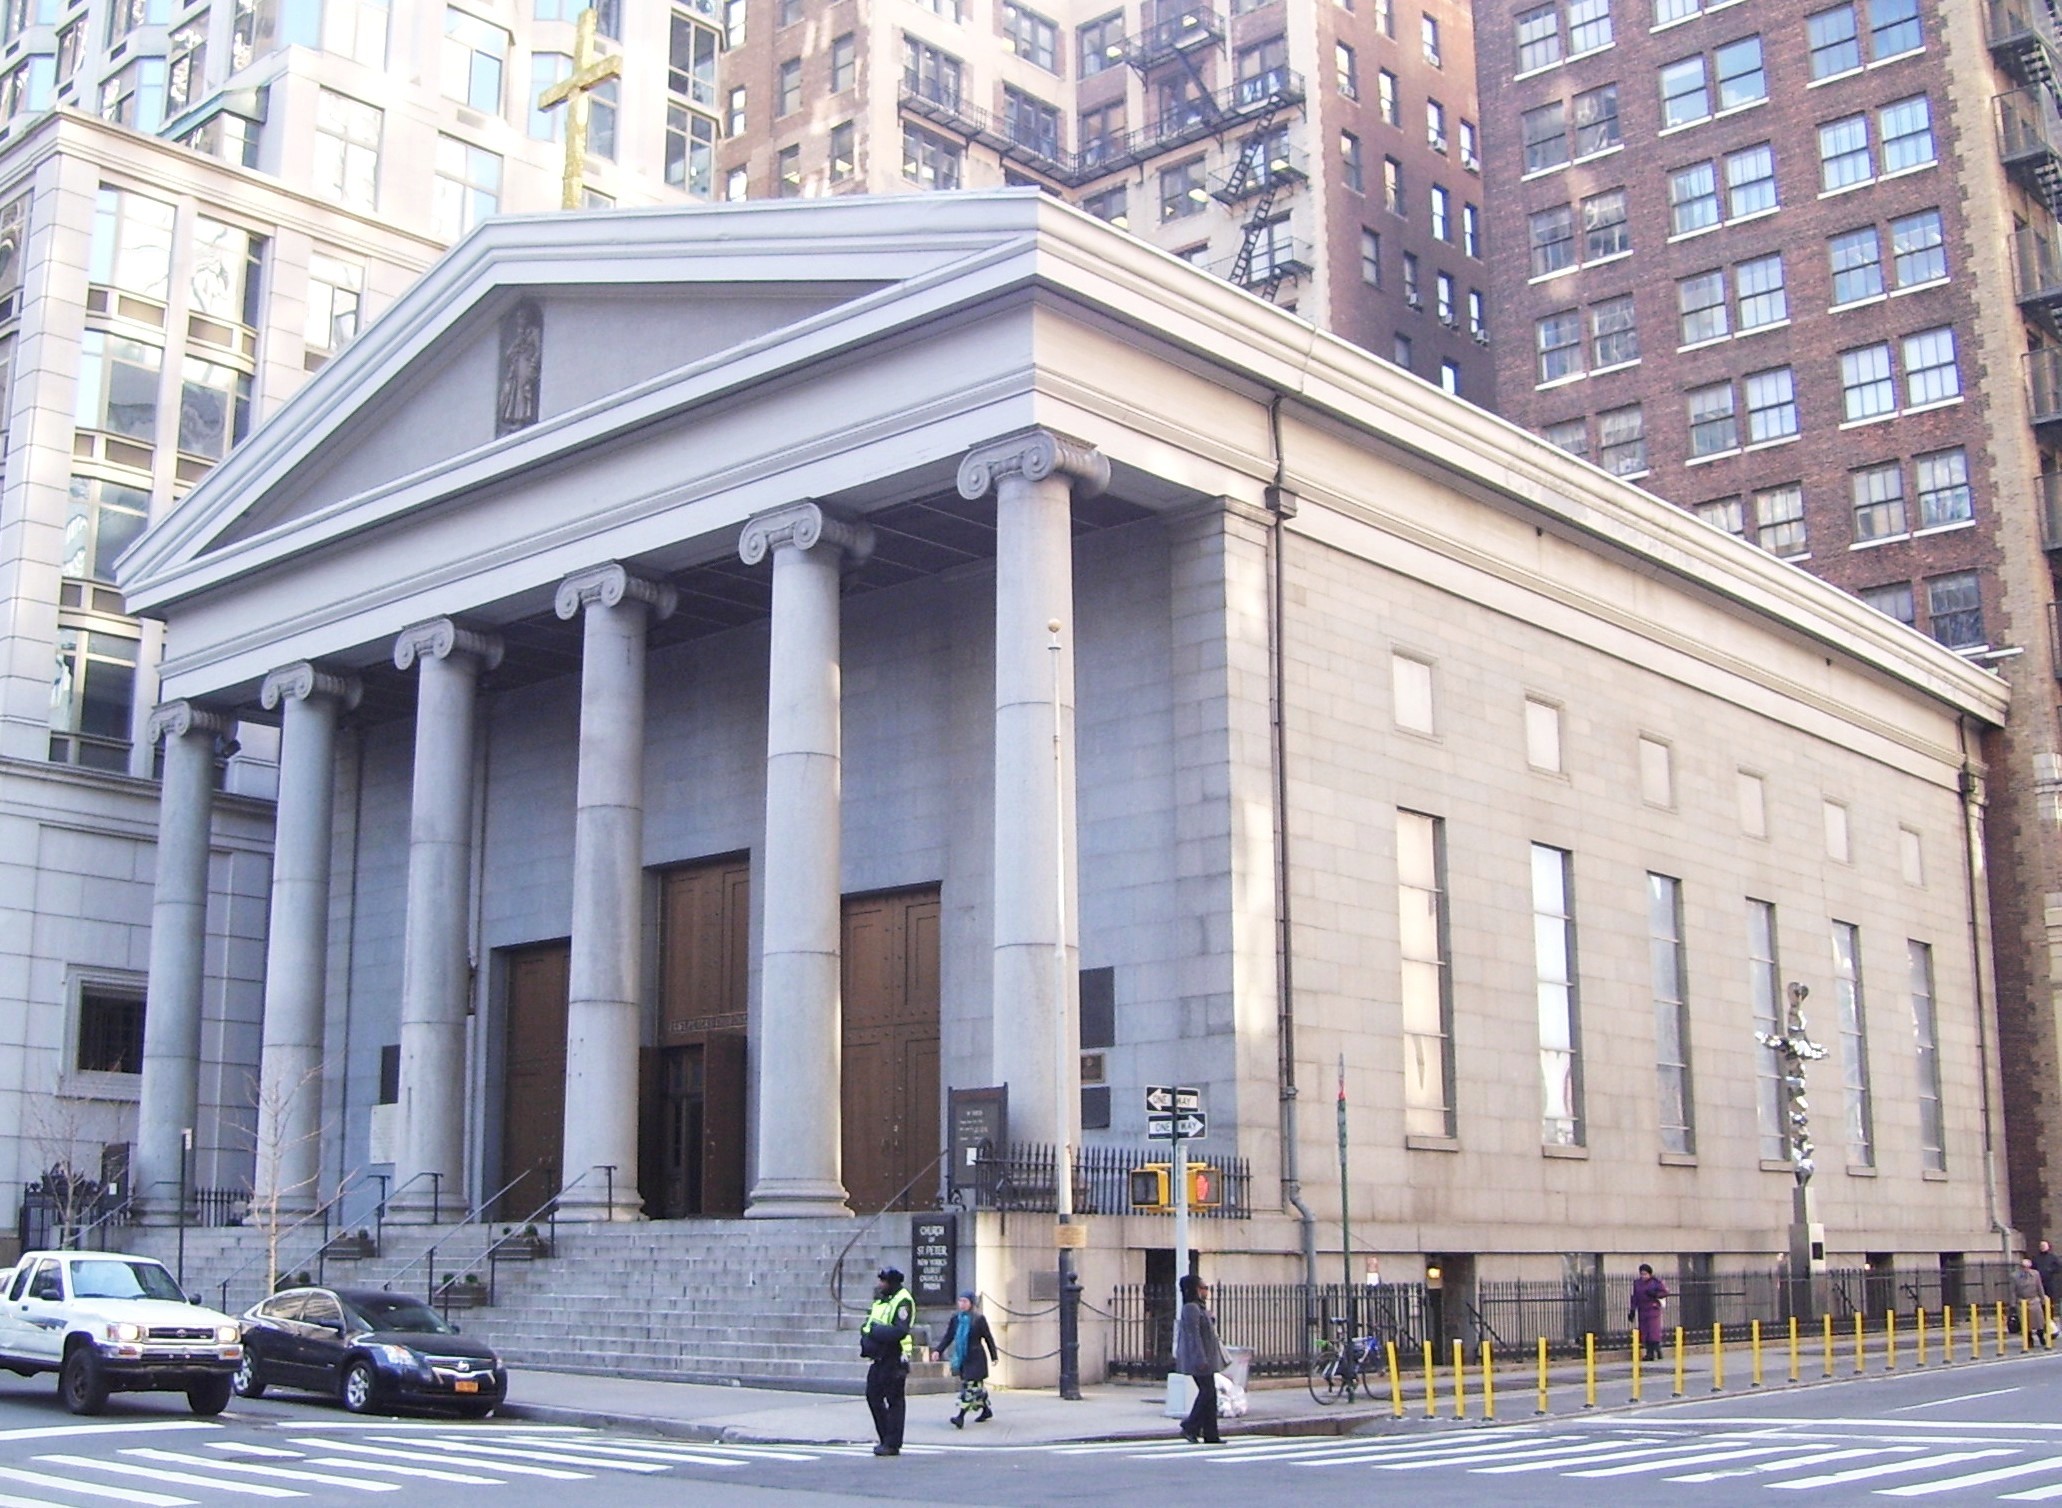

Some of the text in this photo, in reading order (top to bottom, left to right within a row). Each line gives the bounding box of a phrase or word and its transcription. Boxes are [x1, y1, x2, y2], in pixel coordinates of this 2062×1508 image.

[1153, 1094, 1167, 1104] ONE
[1156, 1121, 1197, 1132] ONE WAY
